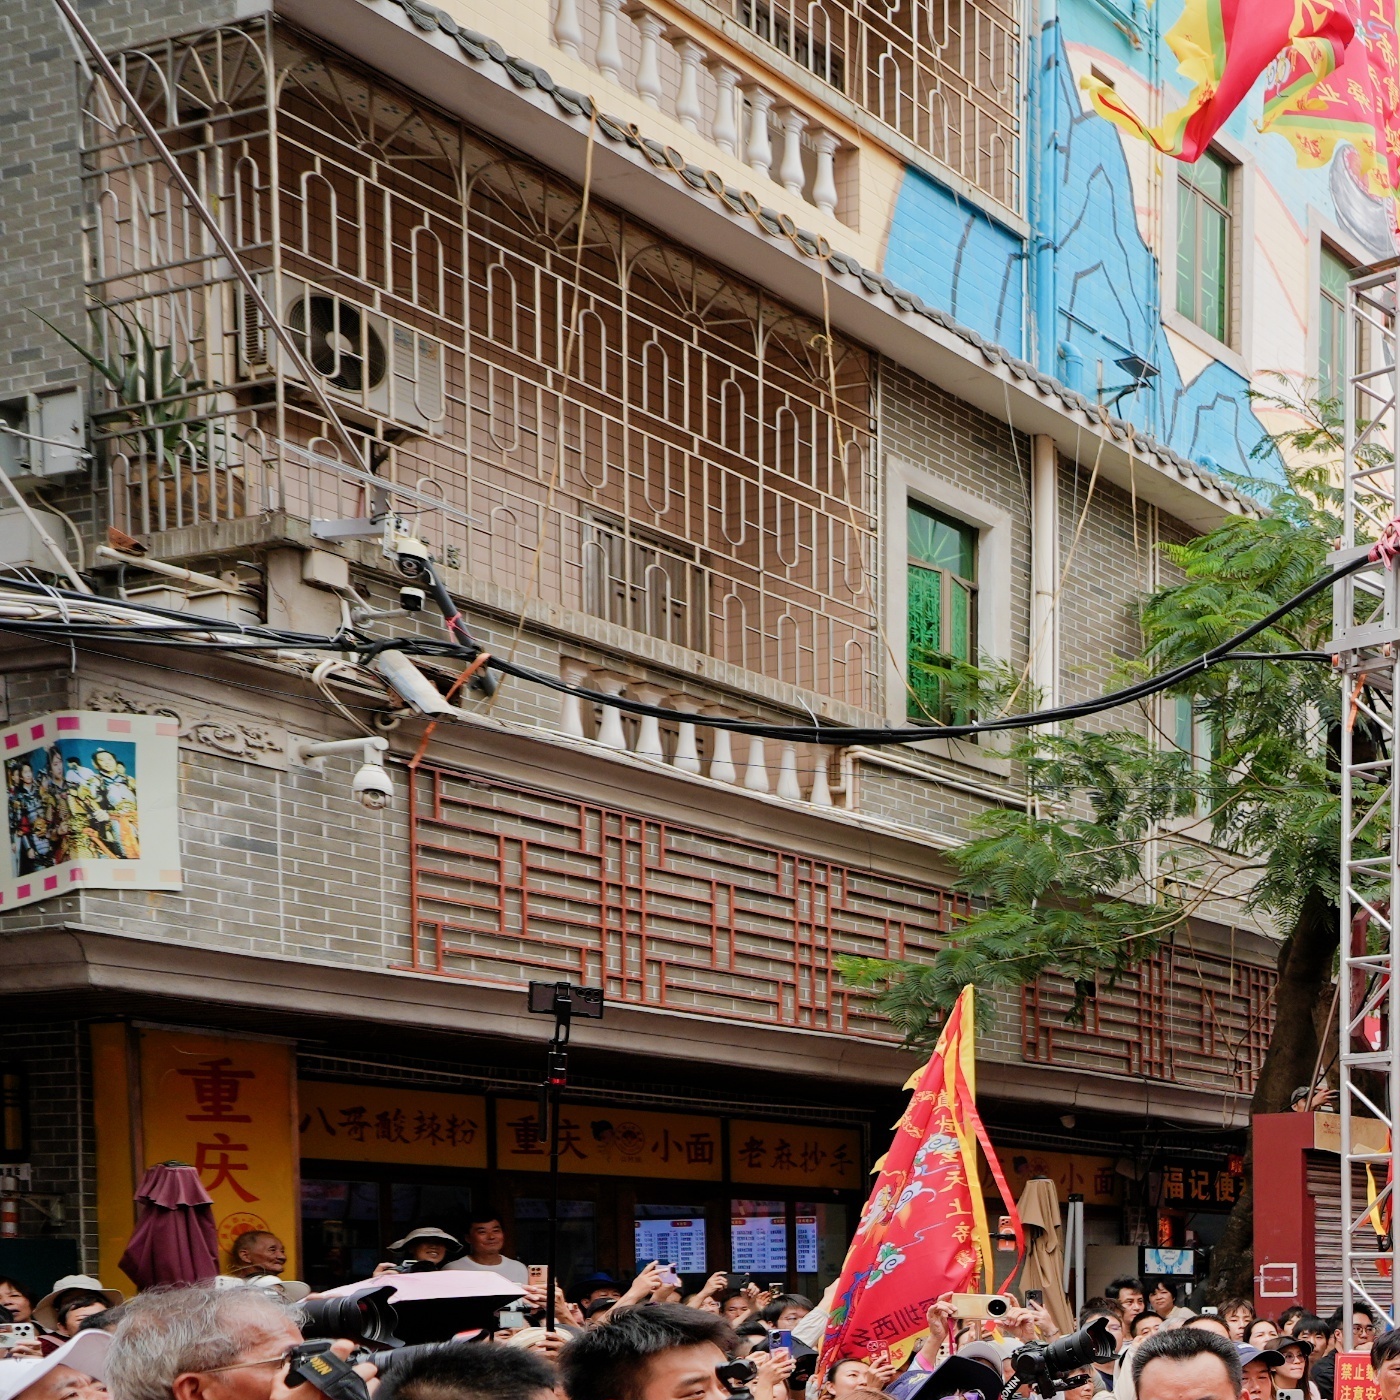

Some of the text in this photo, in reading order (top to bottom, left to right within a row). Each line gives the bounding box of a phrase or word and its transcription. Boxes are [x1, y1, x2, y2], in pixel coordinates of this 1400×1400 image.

[176, 1057, 261, 1203] 重庆
[299, 1105, 479, 1147] 八哥酸辣粉
[506, 1114, 716, 1166] 重庆 小面
[737, 1134, 856, 1177] 老麻抄手
[1060, 1162, 1115, 1197] 小面
